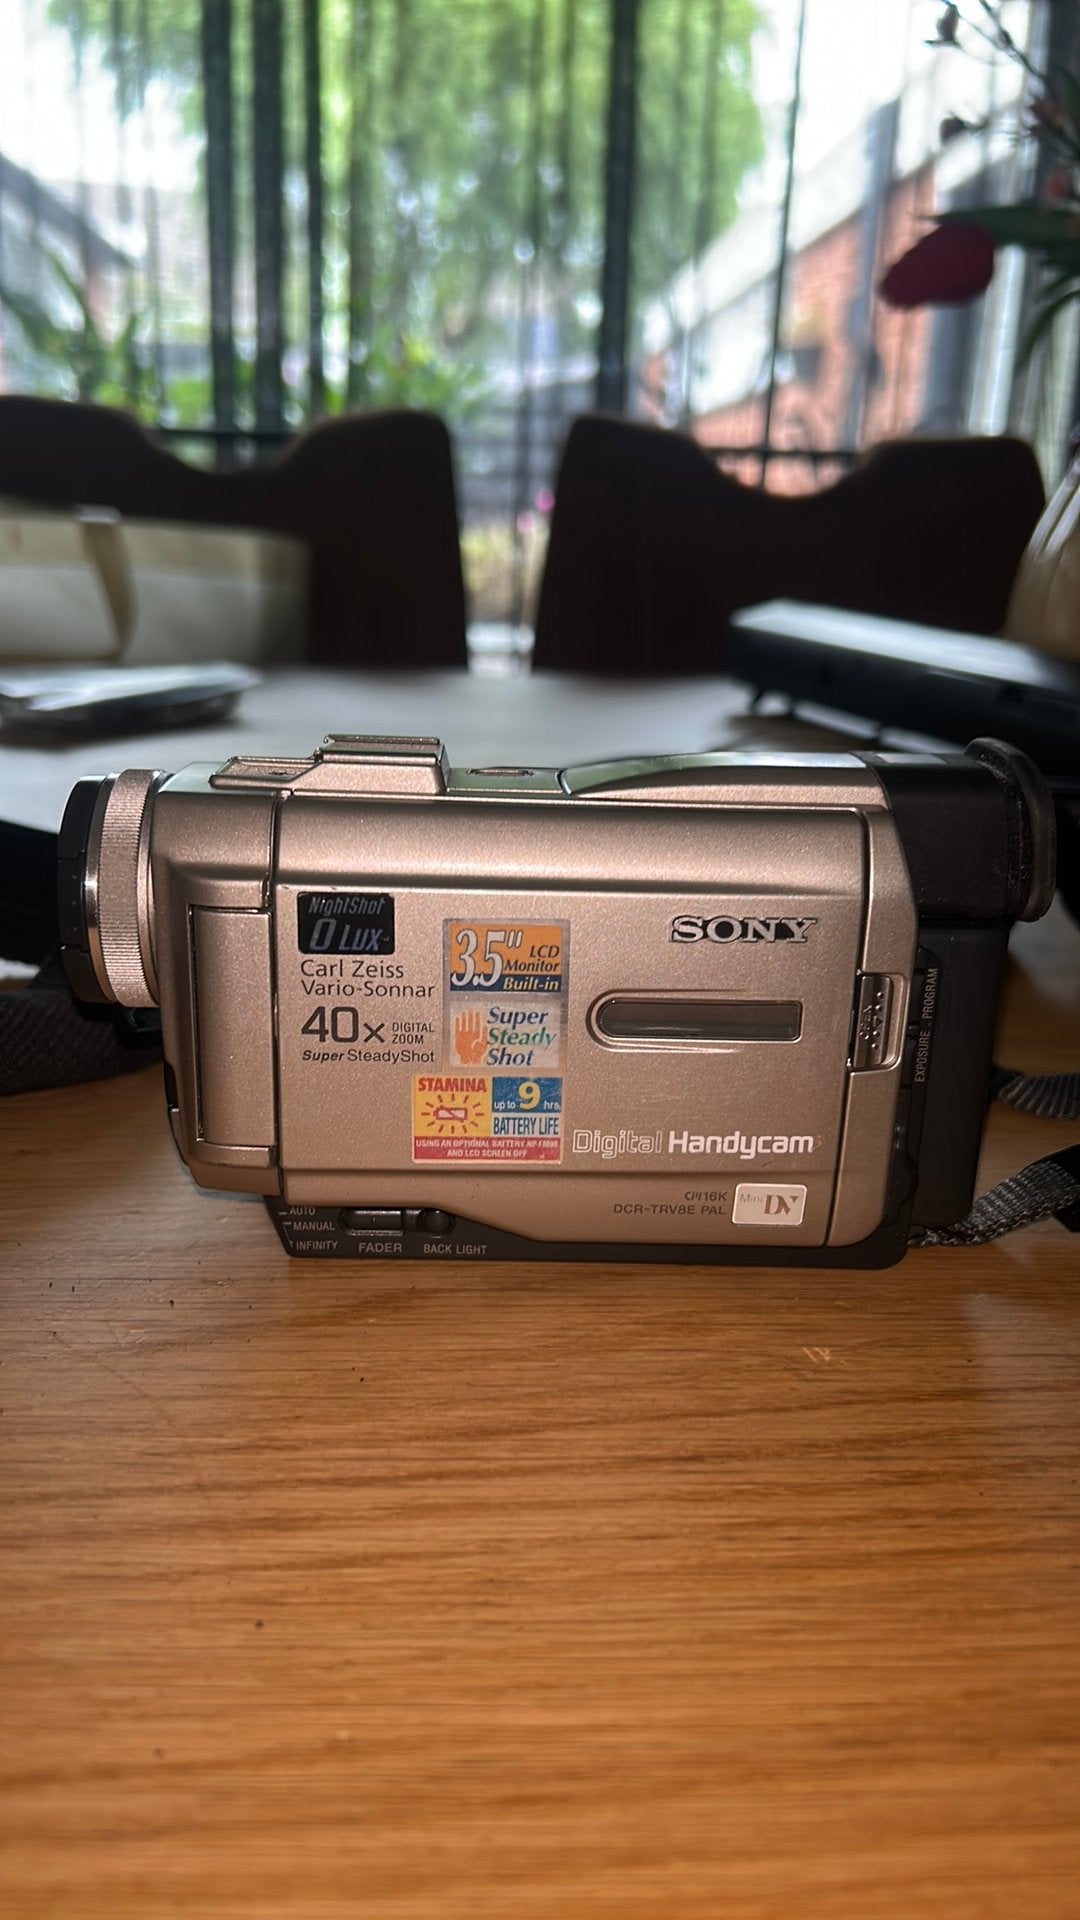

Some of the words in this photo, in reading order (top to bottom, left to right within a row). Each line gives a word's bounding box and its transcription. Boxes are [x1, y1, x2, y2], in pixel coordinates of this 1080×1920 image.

[308, 896, 386, 917] NightShot
[669, 915, 818, 943] SONY
[529, 944, 560, 959] LCD
[300, 959, 343, 979] Carl
[351, 960, 405, 979] Zeiss
[504, 959, 560, 973] Monitor
[301, 979, 435, 998] Vario-Sonnar
[503, 976, 559, 992] Built-in
[922, 968, 938, 1019] PROGRAM
[392, 1022, 434, 1033] DIGITAL
[487, 1007, 549, 1036] Super
[392, 1034, 424, 1045] ZOOM
[487, 1027, 557, 1051] Steady
[302, 1049, 345, 1063] Super
[347, 1048, 435, 1065] SteadyShot
[486, 1048, 535, 1066] Shot
[914, 1031, 931, 1082] EXPOSURE
[418, 1077, 487, 1093] STAMINA
[494, 1101, 505, 1110] up
[506, 1100, 516, 1110] to
[518, 1081, 541, 1110] 9
[493, 1117, 535, 1135] BATTERY
[539, 1117, 559, 1135] LIFE
[416, 1139, 440, 1147] USING
[441, 1139, 452, 1147] AN
[452, 1139, 489, 1147] OPTIONAL
[491, 1139, 525, 1148] BATTERY
[572, 1129, 661, 1159] Digital
[668, 1130, 814, 1159] Handycam
[481, 1150, 512, 1158] SCREEN
[740, 1193, 763, 1203] Mini
[764, 1194, 799, 1215] DV
[289, 1206, 316, 1216] AUTO
[613, 1203, 695, 1214] DCR-TRV8E
[700, 1204, 726, 1215] PAL
[293, 1221, 335, 1231] MANUAL
[296, 1240, 338, 1250] INFINITY
[358, 1242, 403, 1253] FADER
[423, 1244, 451, 1254] BACK
[455, 1244, 488, 1255] LIGHT
